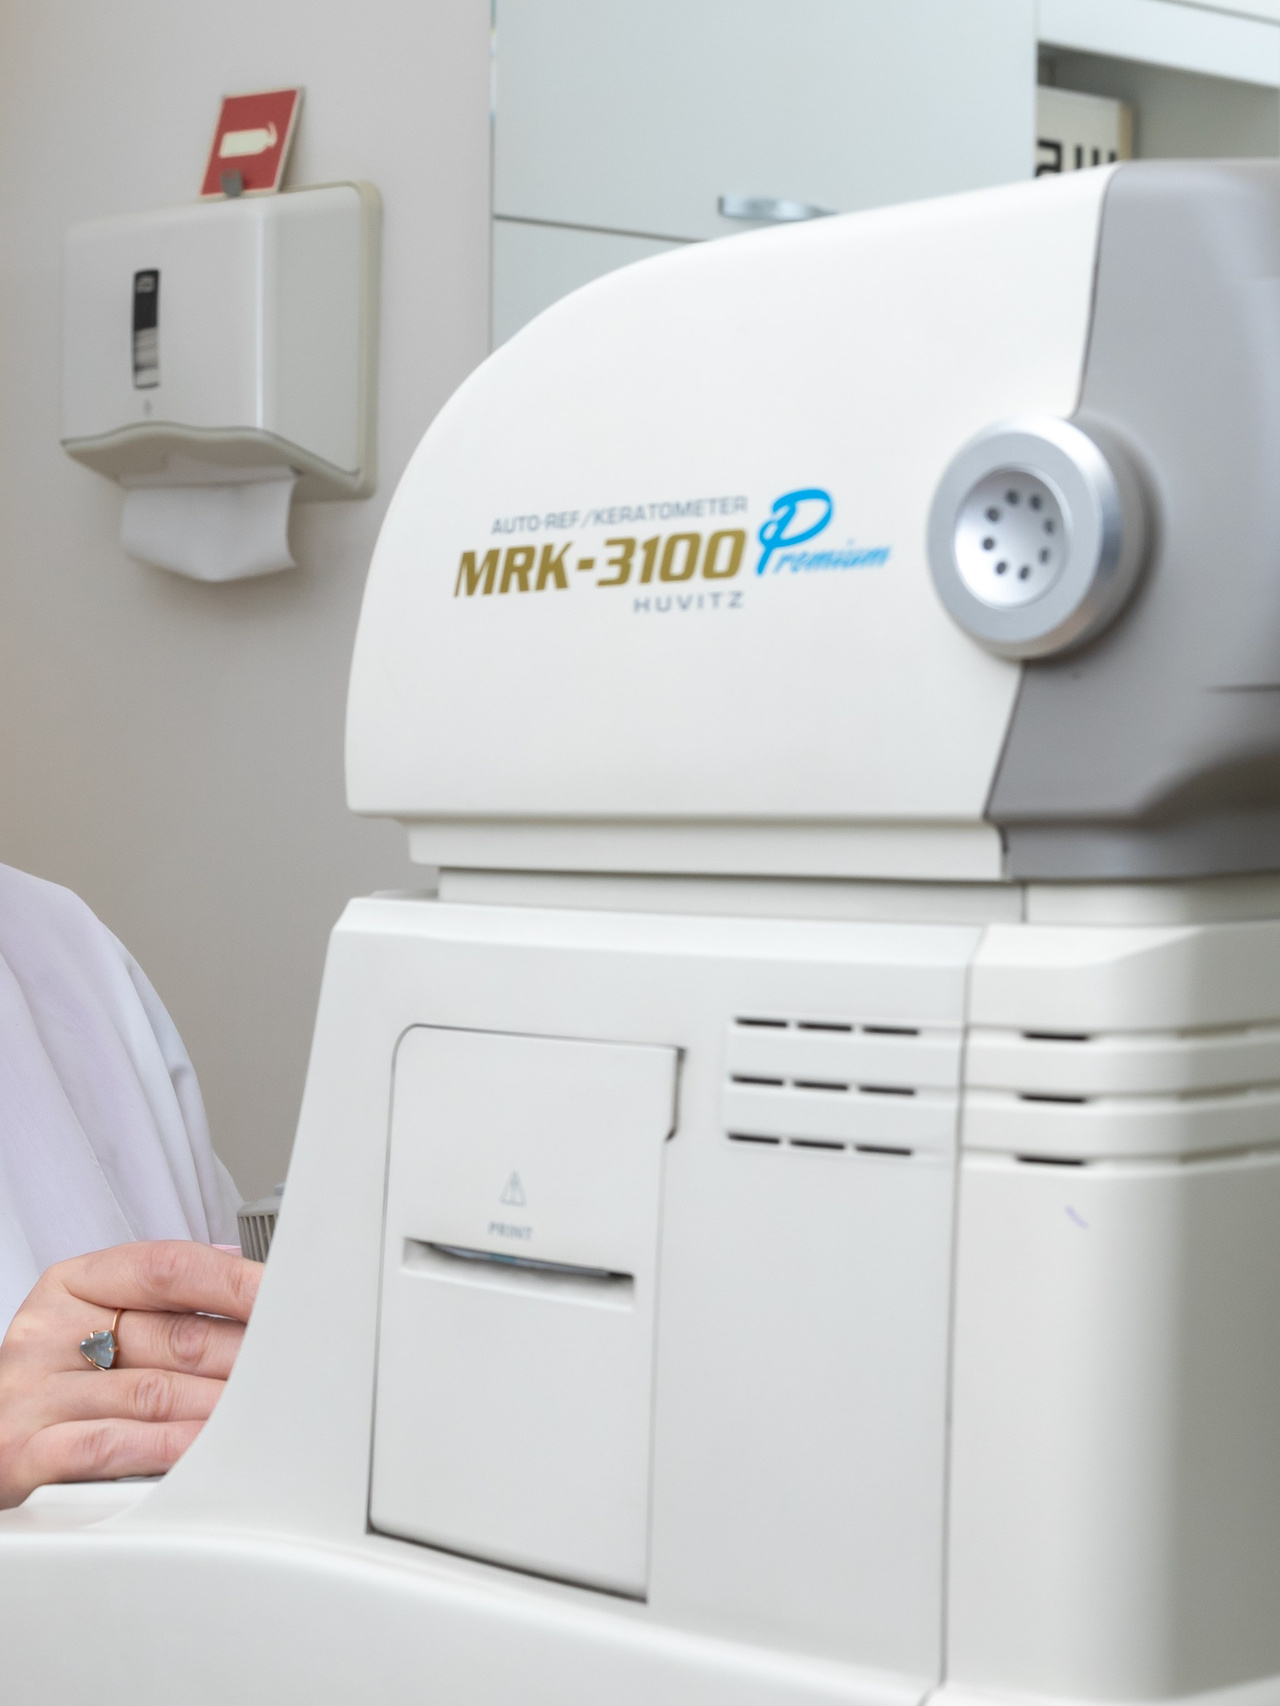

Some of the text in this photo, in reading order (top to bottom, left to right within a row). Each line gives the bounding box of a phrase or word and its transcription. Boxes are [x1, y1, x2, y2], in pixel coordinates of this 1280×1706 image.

[453, 488, 891, 597] MRK-3100 Premium
[633, 590, 745, 613] HUVITZ
